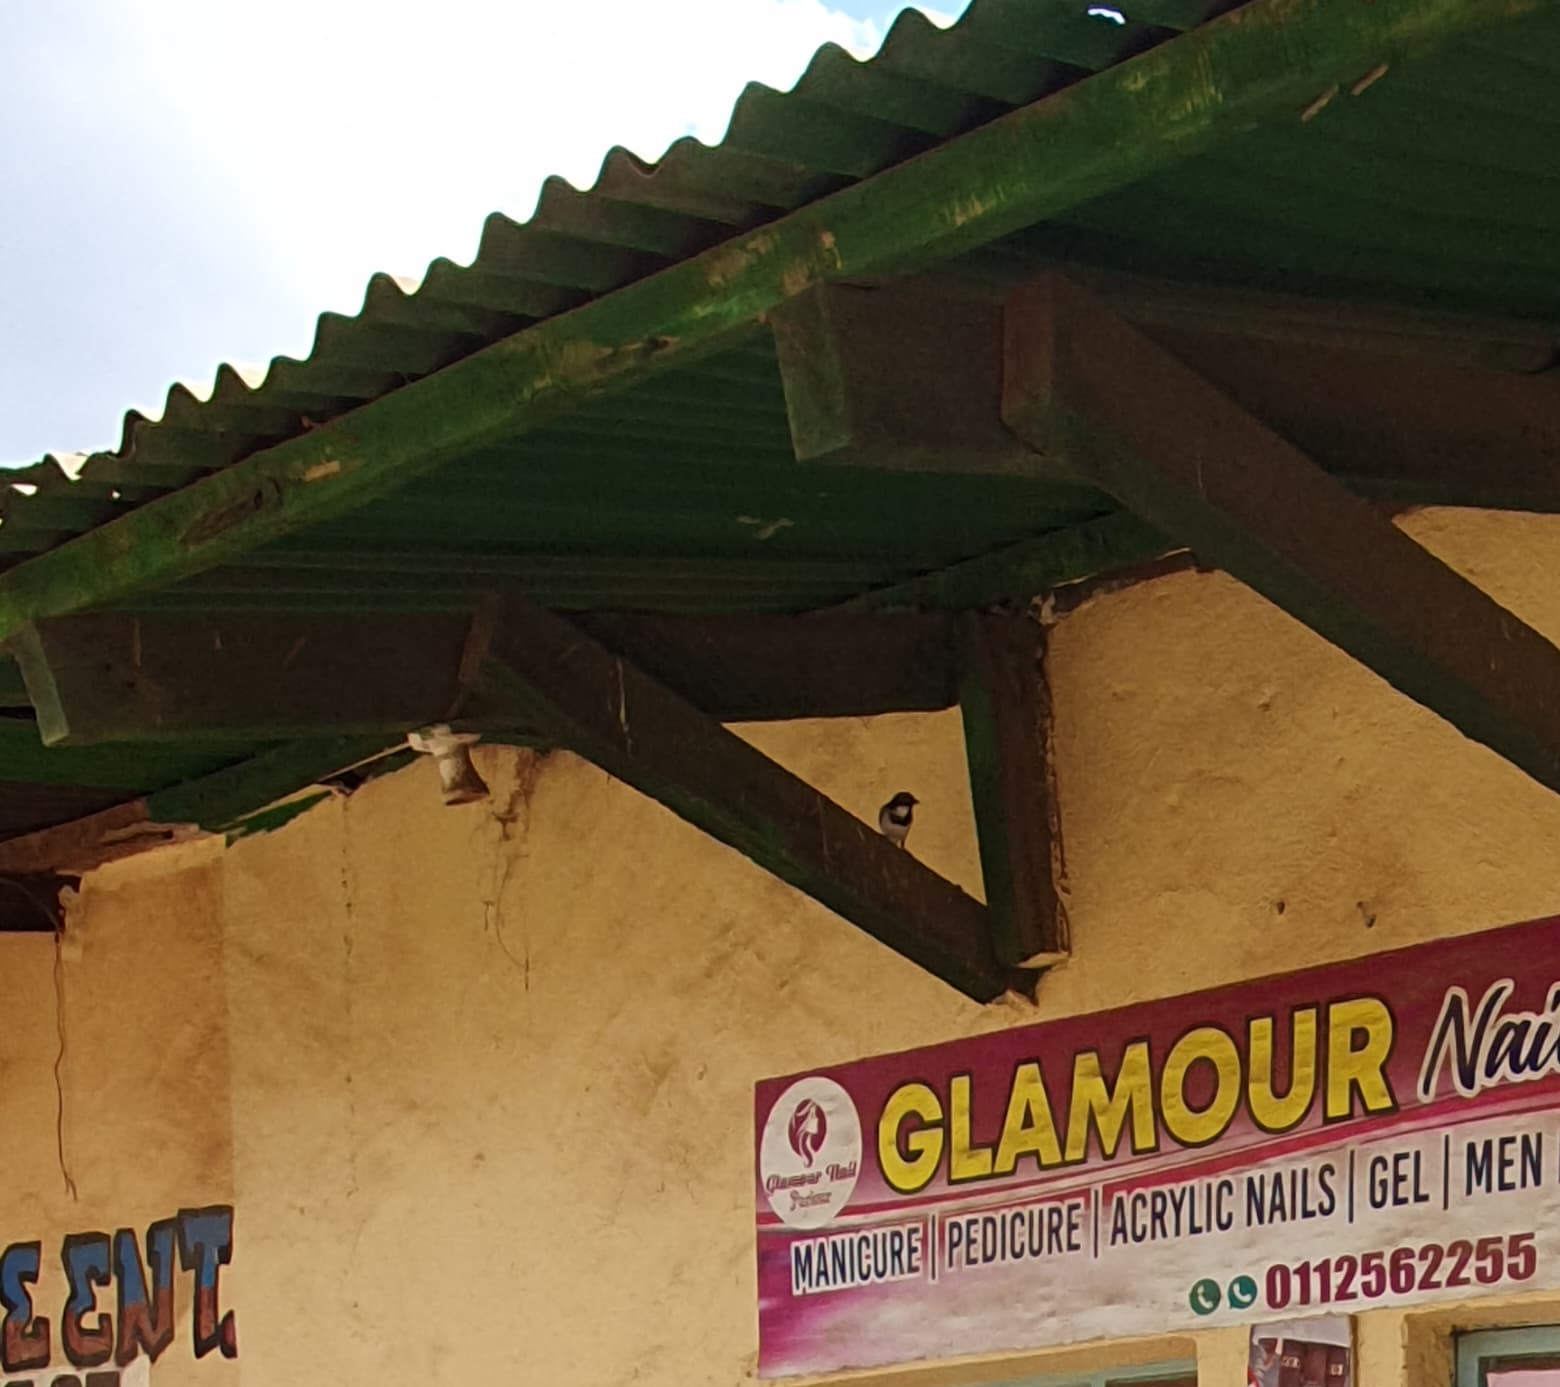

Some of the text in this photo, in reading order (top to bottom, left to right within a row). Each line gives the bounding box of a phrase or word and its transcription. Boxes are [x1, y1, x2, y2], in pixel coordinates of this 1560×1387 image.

[876, 996, 1395, 1195] GLAMOUR
[793, 1227, 921, 1293] MANICURE
[946, 1202, 1081, 1267] PEDICURE
[1110, 1179, 1234, 1246] ACRYLIC
[1245, 1164, 1336, 1227] NAILS
[1368, 1151, 1429, 1208] GEL
[1465, 1130, 1543, 1197] MEN
[1265, 1232, 1537, 1309] 0112562255
